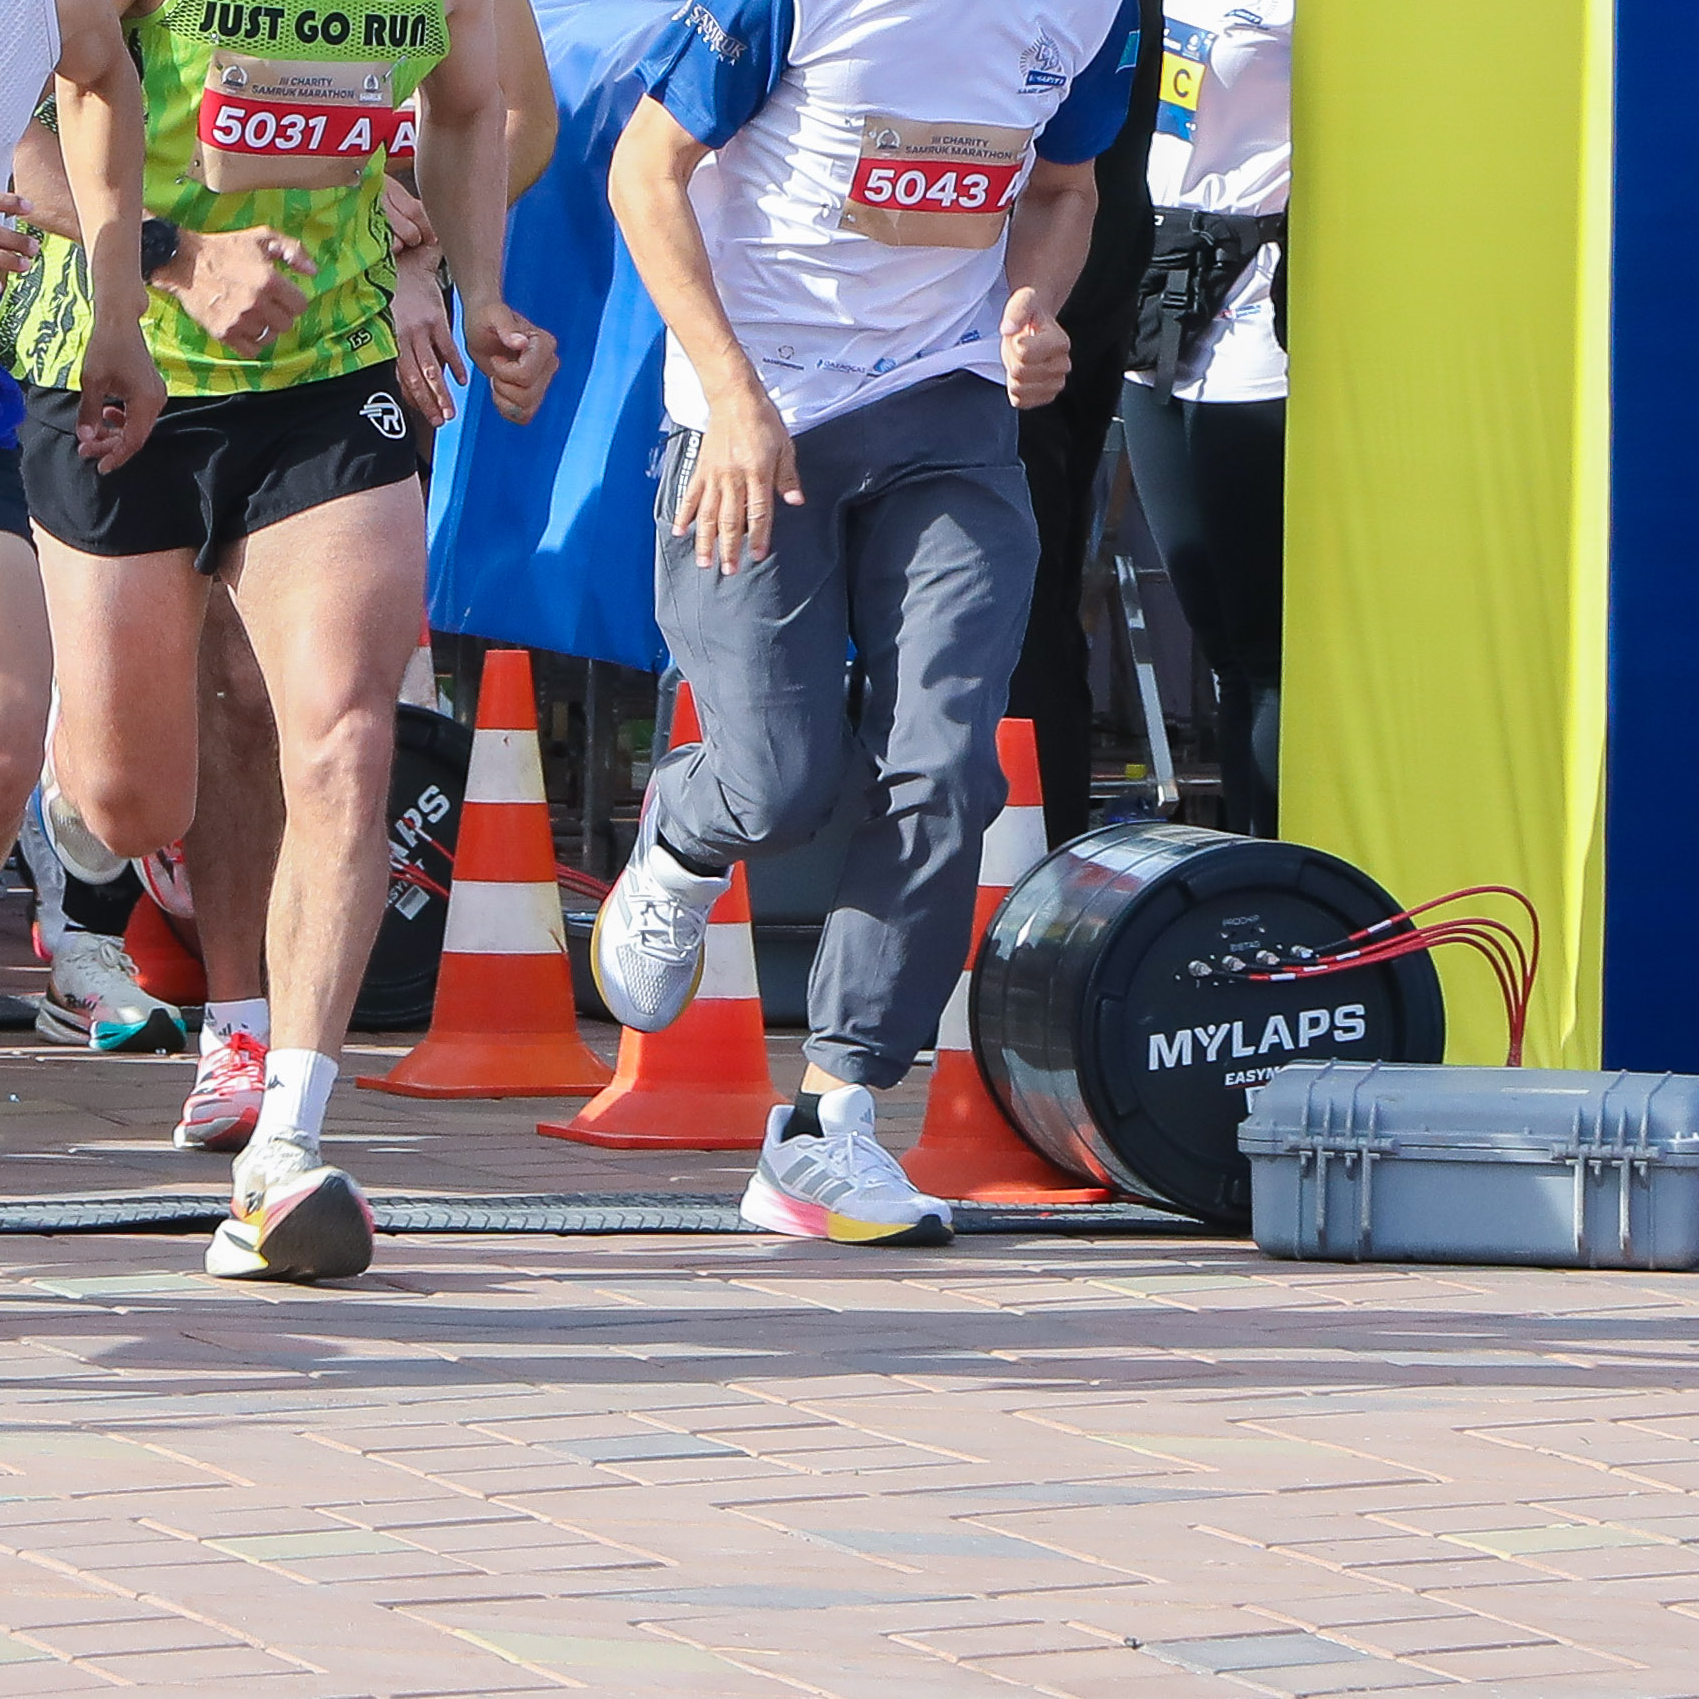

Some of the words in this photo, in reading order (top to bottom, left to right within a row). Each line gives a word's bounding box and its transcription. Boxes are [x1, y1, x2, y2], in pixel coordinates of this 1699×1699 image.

[199, 1, 285, 40] JUST
[295, 10, 351, 46] GO
[362, 13, 426, 47] RUN
[252, 85, 297, 97] SAMRUK
[298, 89, 354, 99] MARATHON
[291, 78, 333, 87] CHARITY
[1174, 68, 1192, 98] C
[212, 105, 328, 150] 5031
[338, 118, 372, 150] A
[390, 121, 416, 153] A
[943, 137, 989, 147] CHARITY
[905, 146, 951, 155] SAMRUK
[952, 149, 1012, 159] MARATHON
[863, 168, 989, 208] 5043
[1148, 1003, 1366, 1071] MYLAPS
